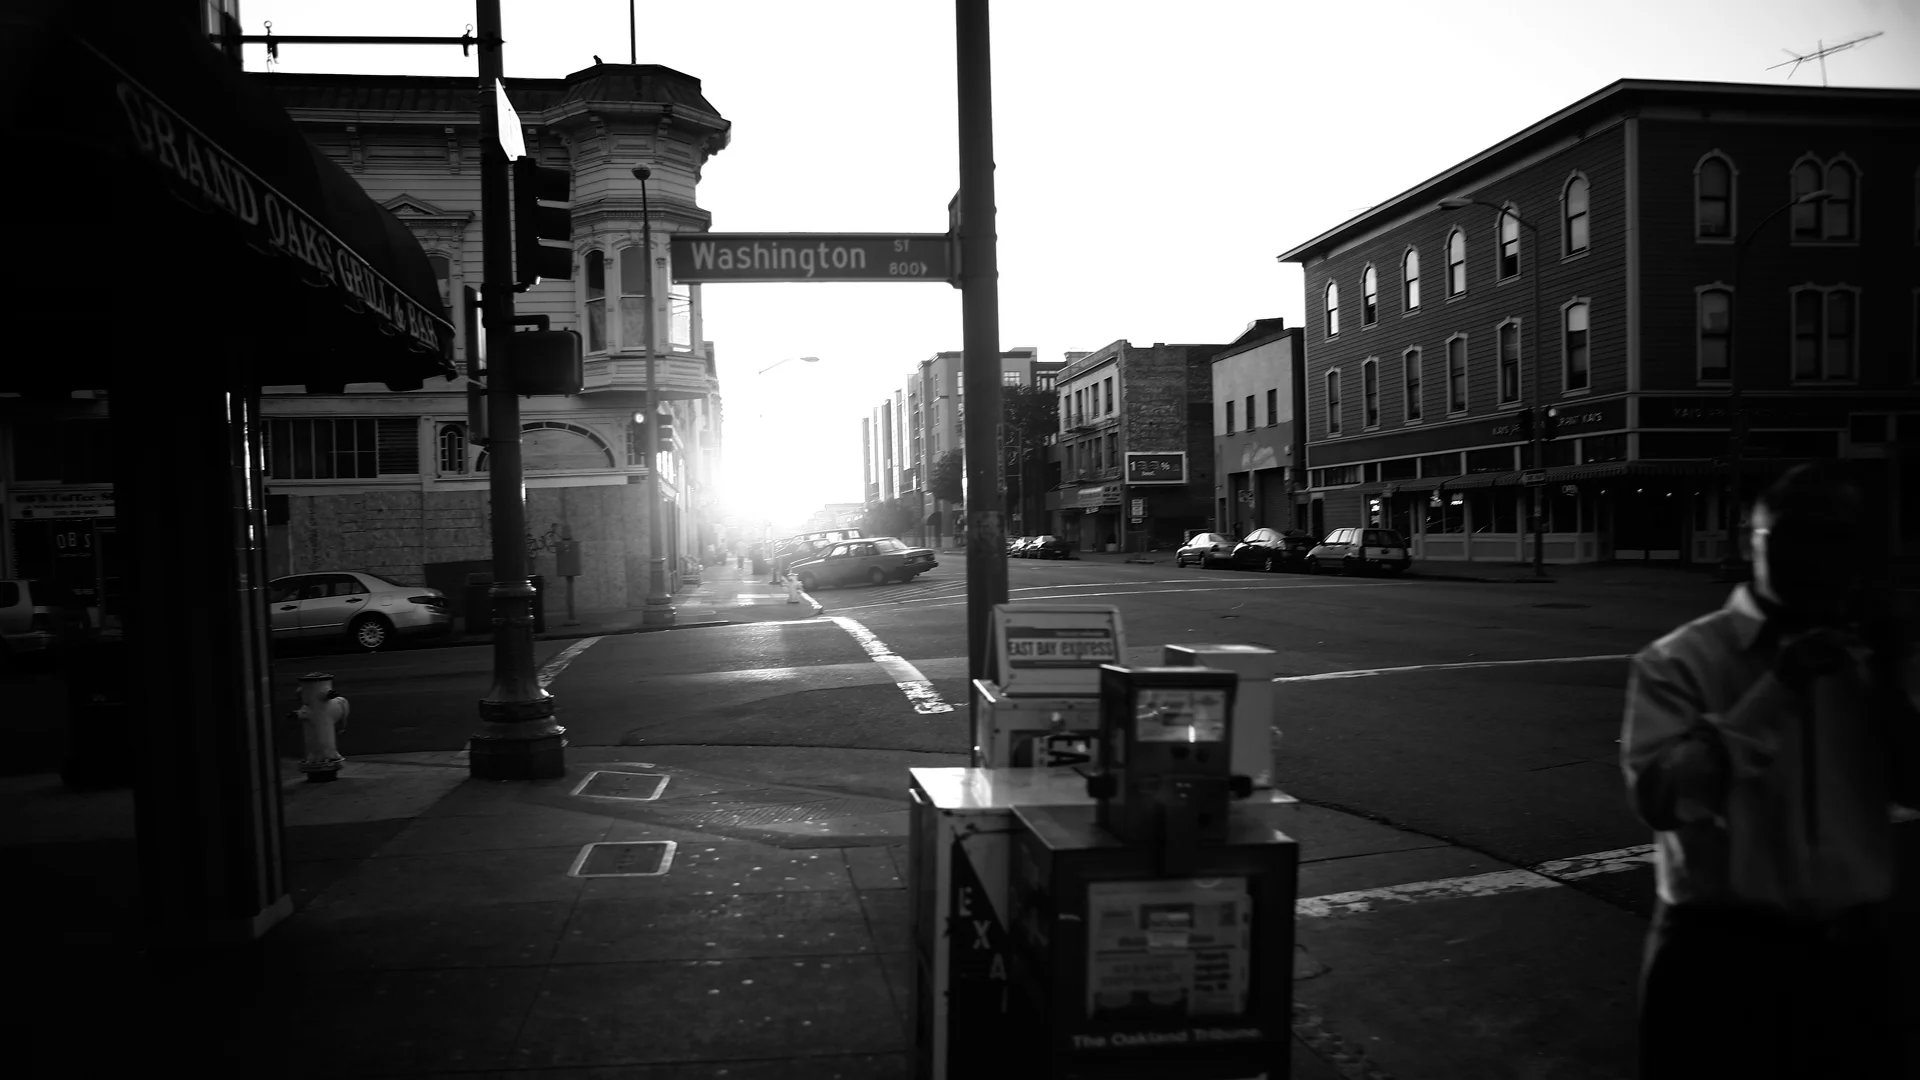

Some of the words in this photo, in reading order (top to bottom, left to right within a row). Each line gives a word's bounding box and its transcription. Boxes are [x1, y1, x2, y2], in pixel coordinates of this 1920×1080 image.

[115, 79, 259, 227] GRAND
[263, 191, 336, 278] OAKS
[336, 248, 393, 320] GRILL
[392, 293, 407, 333] &
[407, 300, 439, 347] BAR
[690, 241, 867, 278] Washington
[893, 239, 910, 253] ST
[888, 261, 920, 276] 800
[1007, 640, 1034, 656] EAST
[1036, 640, 1057, 656] BAY
[1060, 641, 1114, 661] express
[1071, 1033, 1107, 1050] The
[1109, 1029, 1189, 1047] Oakland
[1191, 1027, 1264, 1044] Tribune
